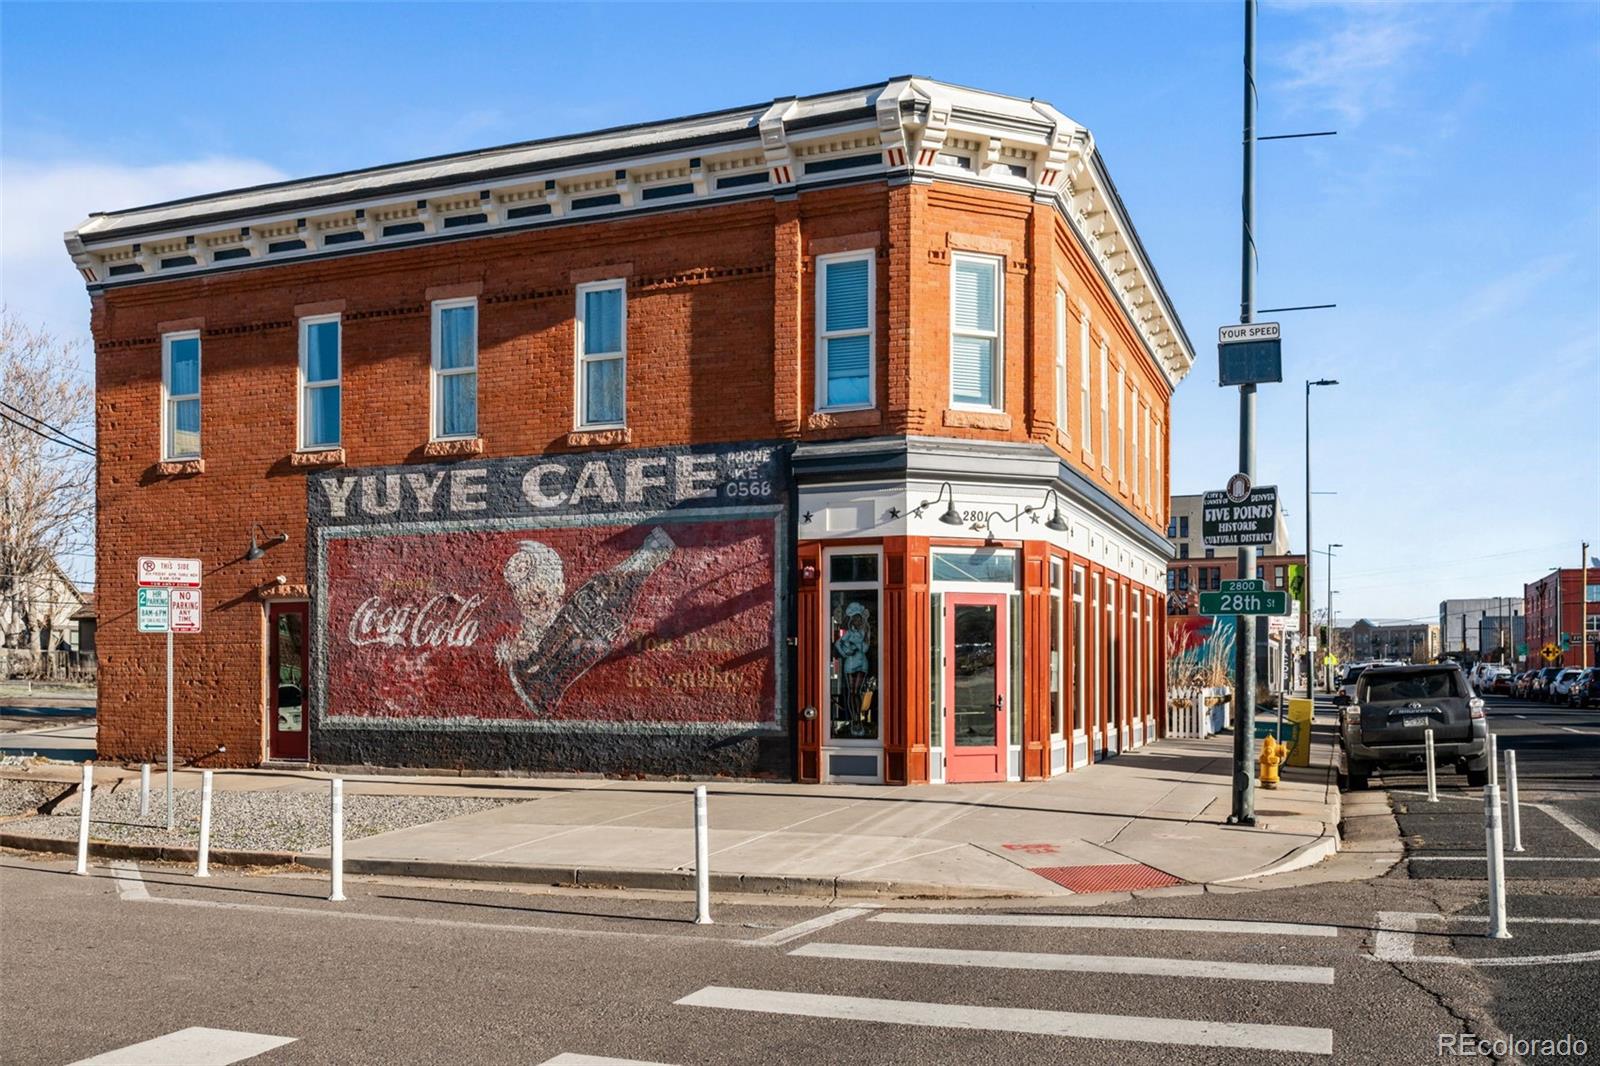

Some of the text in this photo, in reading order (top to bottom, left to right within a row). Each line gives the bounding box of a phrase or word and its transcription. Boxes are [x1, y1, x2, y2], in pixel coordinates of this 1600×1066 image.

[1221, 326, 1278, 339] YOUR SPEED
[727, 450, 771, 464] PHONE
[319, 453, 717, 517] YUYE CAFE
[726, 480, 772, 497] 0568
[1251, 493, 1275, 502] DENVER
[963, 510, 989, 522] 2801
[1205, 505, 1273, 522] FIVE POINTS
[1218, 521, 1258, 532] HISTORIC
[1204, 532, 1272, 544] CULTURAL DISTRICT
[1229, 581, 1255, 591] 2800
[140, 592, 145, 605] 2
[179, 591, 191, 600] NO
[172, 602, 198, 610] PARKING
[1220, 594, 1275, 611] 28th St
